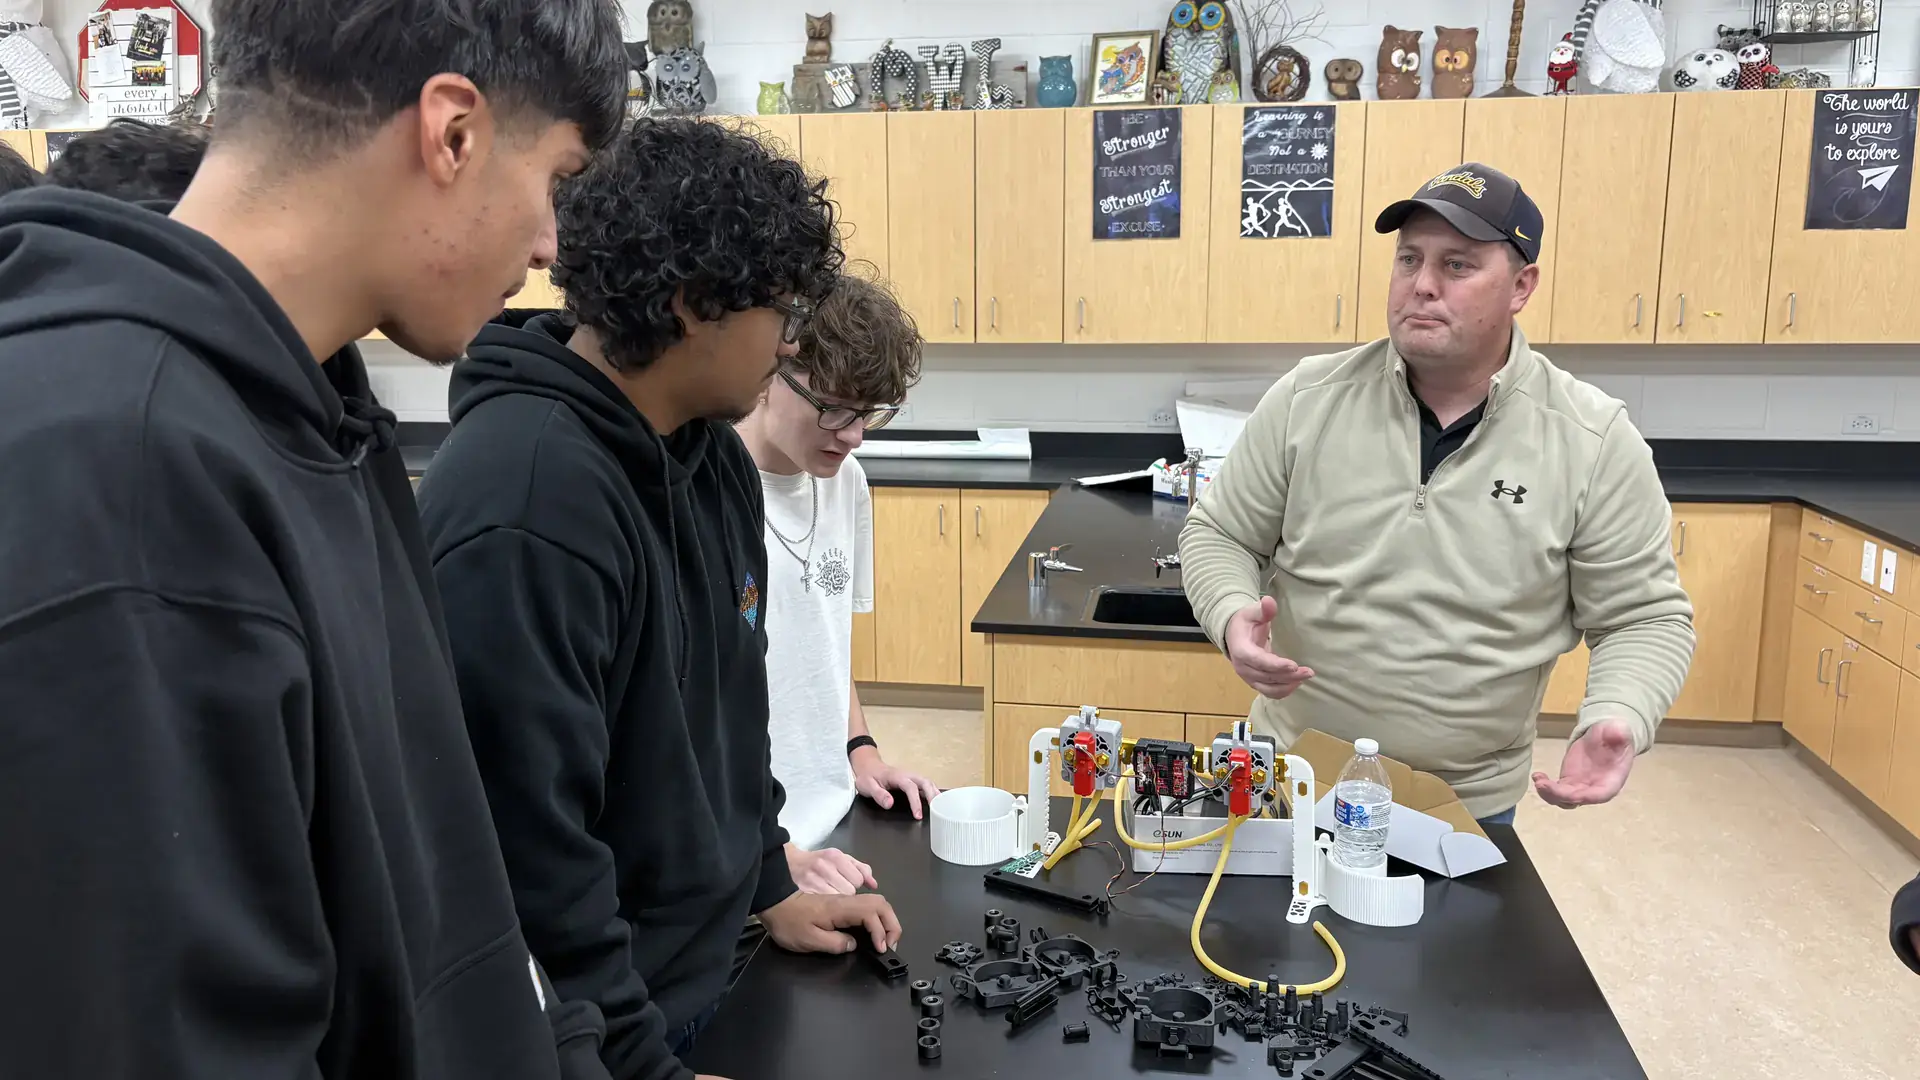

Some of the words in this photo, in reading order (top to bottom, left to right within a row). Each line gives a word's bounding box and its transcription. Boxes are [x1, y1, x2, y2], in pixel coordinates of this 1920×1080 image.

[124, 89, 157, 99] every
[1823, 93, 1860, 111] The
[1863, 92, 1909, 110] world
[1254, 110, 1308, 125] Learning
[1313, 110, 1325, 121] is
[1257, 130, 1269, 138] a
[1835, 116, 1848, 135] is
[1849, 122, 1892, 140] yours
[1102, 127, 1170, 155] Stronger
[1297, 147, 1307, 155] a
[1824, 143, 1842, 161] to
[1846, 142, 1900, 166] explore
[1099, 166, 1136, 178] THAN
[1138, 164, 1175, 177] YOUR
[1247, 162, 1328, 175] DESTINATION
[1099, 178, 1173, 214] Strongest
[1153, 829, 1183, 838] eSUN
